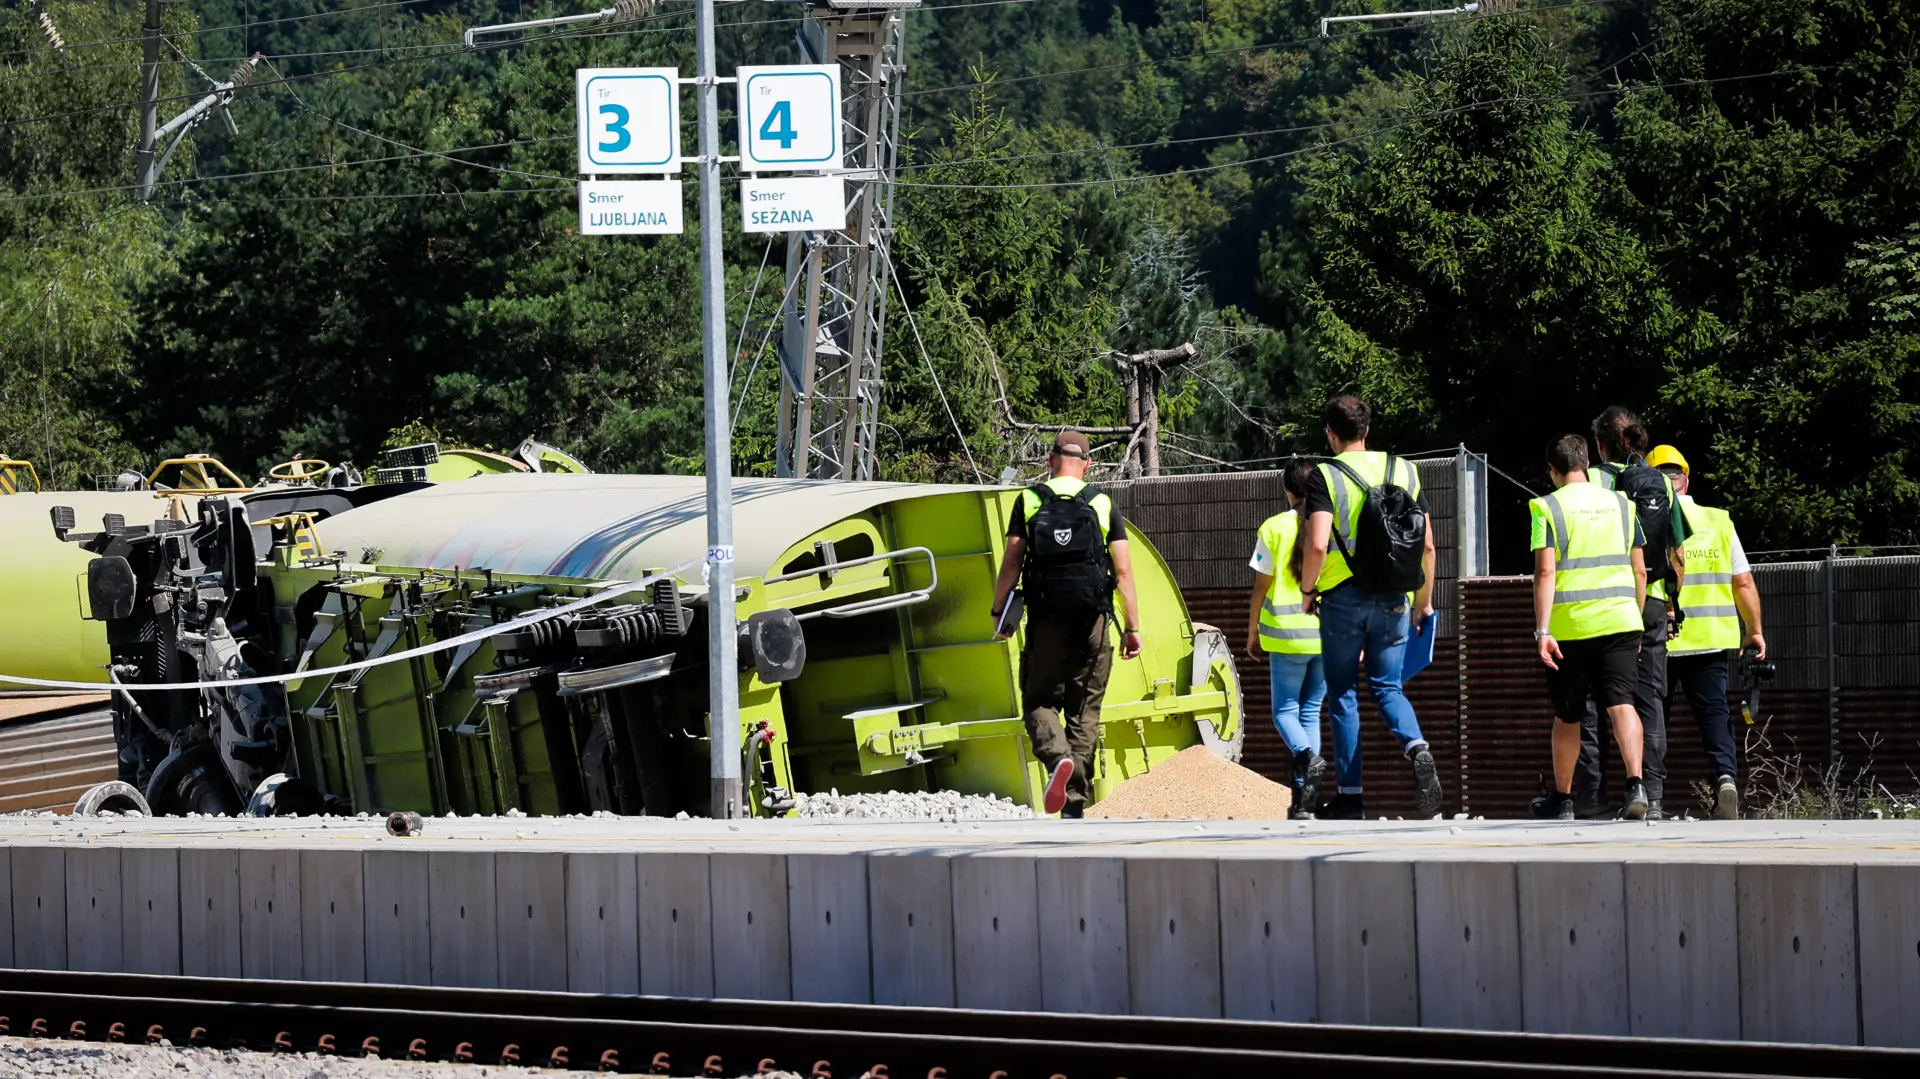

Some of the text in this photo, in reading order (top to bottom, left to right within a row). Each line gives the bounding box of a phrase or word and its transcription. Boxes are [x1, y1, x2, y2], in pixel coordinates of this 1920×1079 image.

[598, 89, 611, 98] Tir
[759, 86, 772, 95] Tir
[599, 104, 631, 152] 3
[759, 101, 797, 149] 4
[588, 192, 624, 203] Smer
[749, 190, 786, 202] Smer
[590, 212, 668, 226] LJUBLJANA
[751, 206, 814, 224] SEŽANA
[1683, 549, 1719, 559] OVALEC
